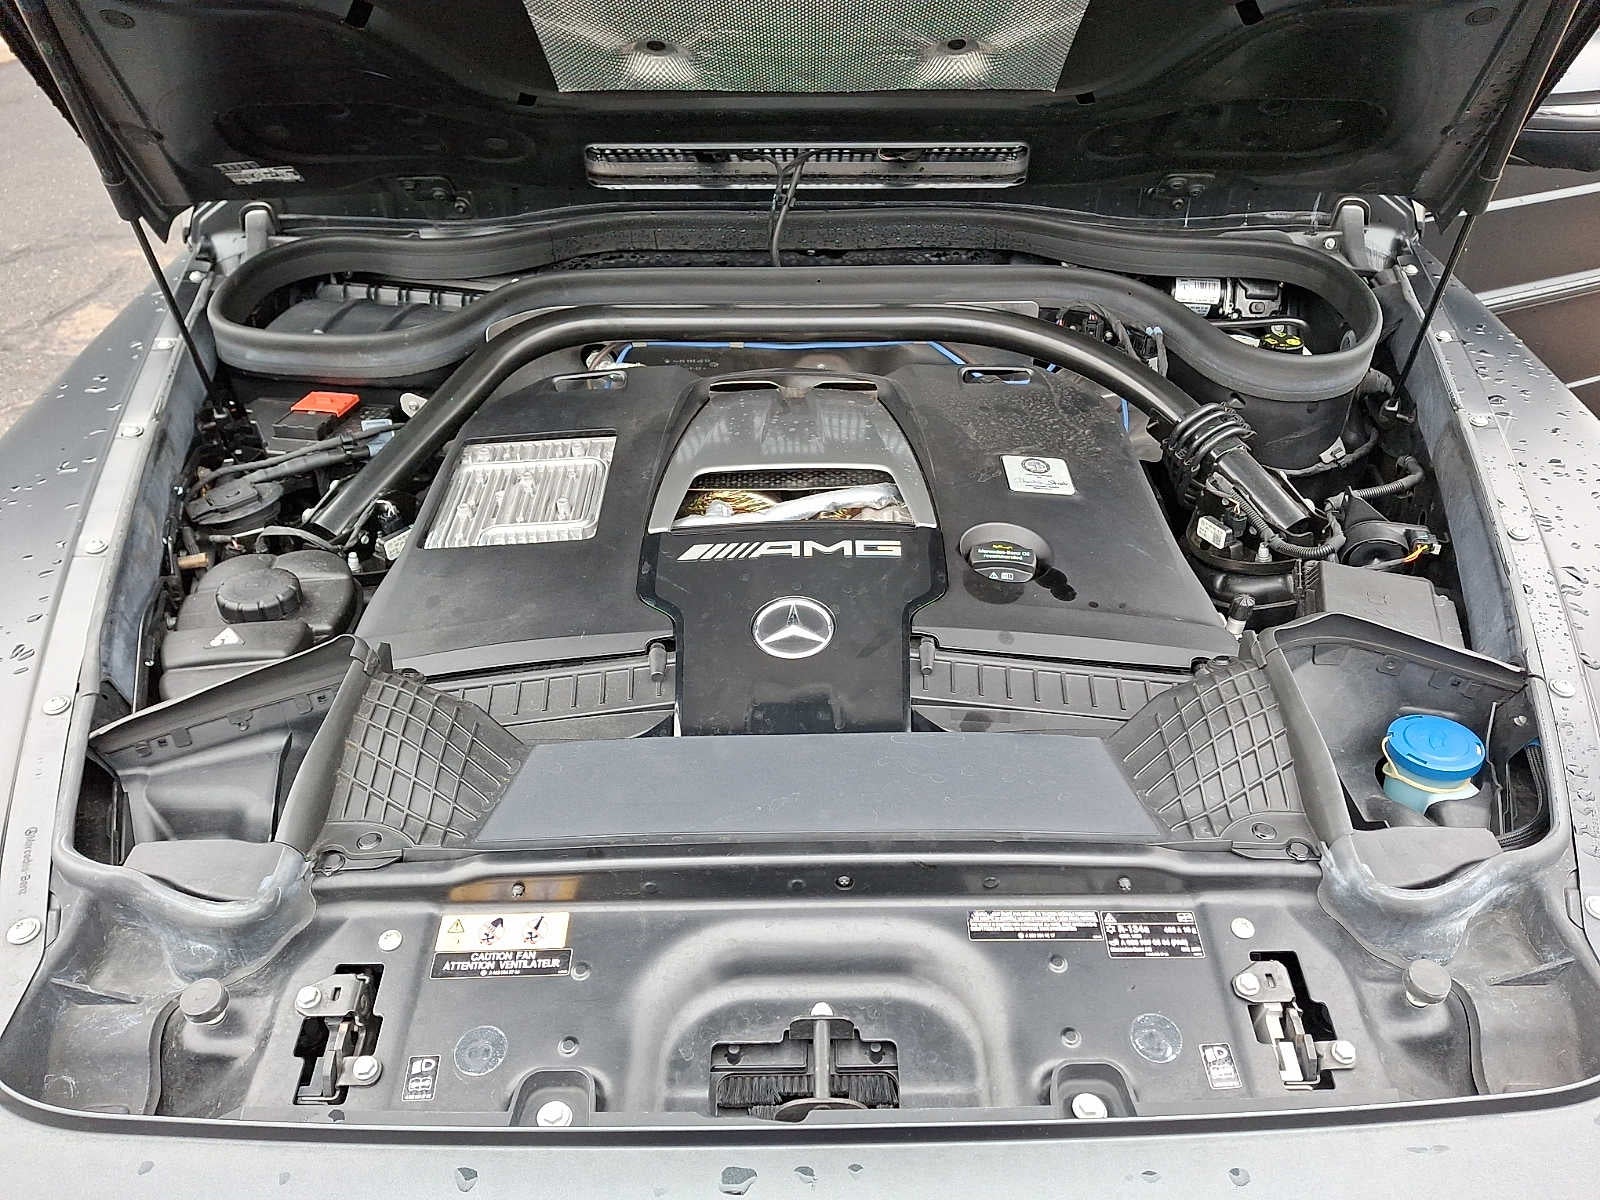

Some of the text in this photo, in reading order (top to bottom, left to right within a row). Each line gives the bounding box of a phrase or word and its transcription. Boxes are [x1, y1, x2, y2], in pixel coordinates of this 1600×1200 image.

[749, 540, 902, 559] AMG
[470, 951, 537, 961] CAUTION FAN
[442, 958, 560, 971] ATTENTION VENTILATEUR
